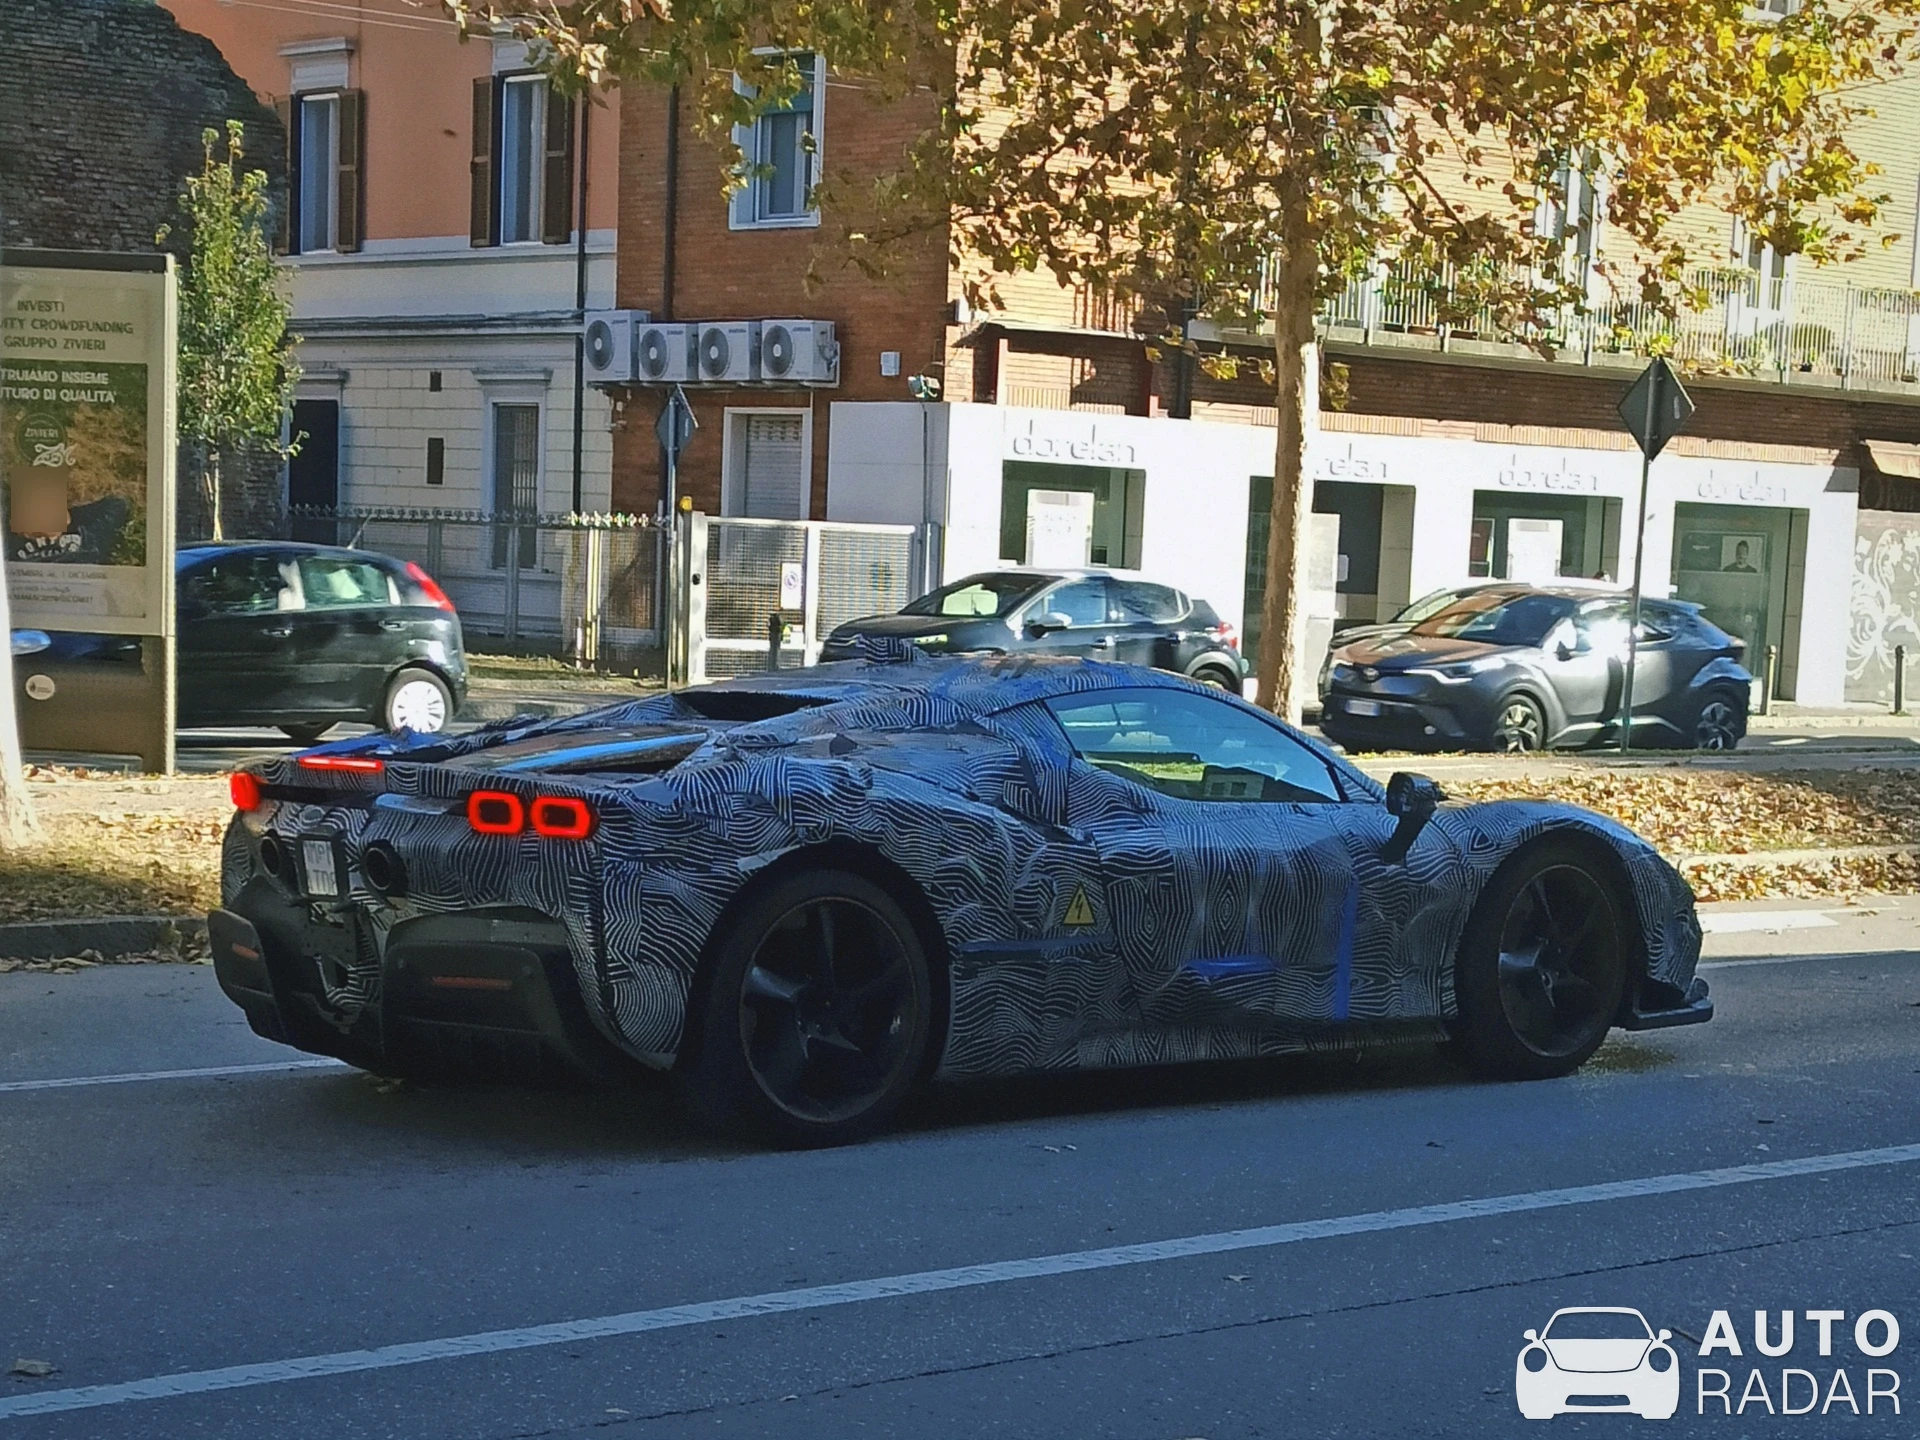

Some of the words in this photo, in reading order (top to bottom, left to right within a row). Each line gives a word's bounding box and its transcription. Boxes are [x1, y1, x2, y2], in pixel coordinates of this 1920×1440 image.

[17, 299, 65, 313] INVESTI
[30, 318, 134, 334] CROWDFUNDING
[3, 335, 57, 349] GRUPPO
[63, 338, 106, 351] ZIVIERI
[61, 372, 109, 385] INSIEME
[43, 388, 56, 401] DI
